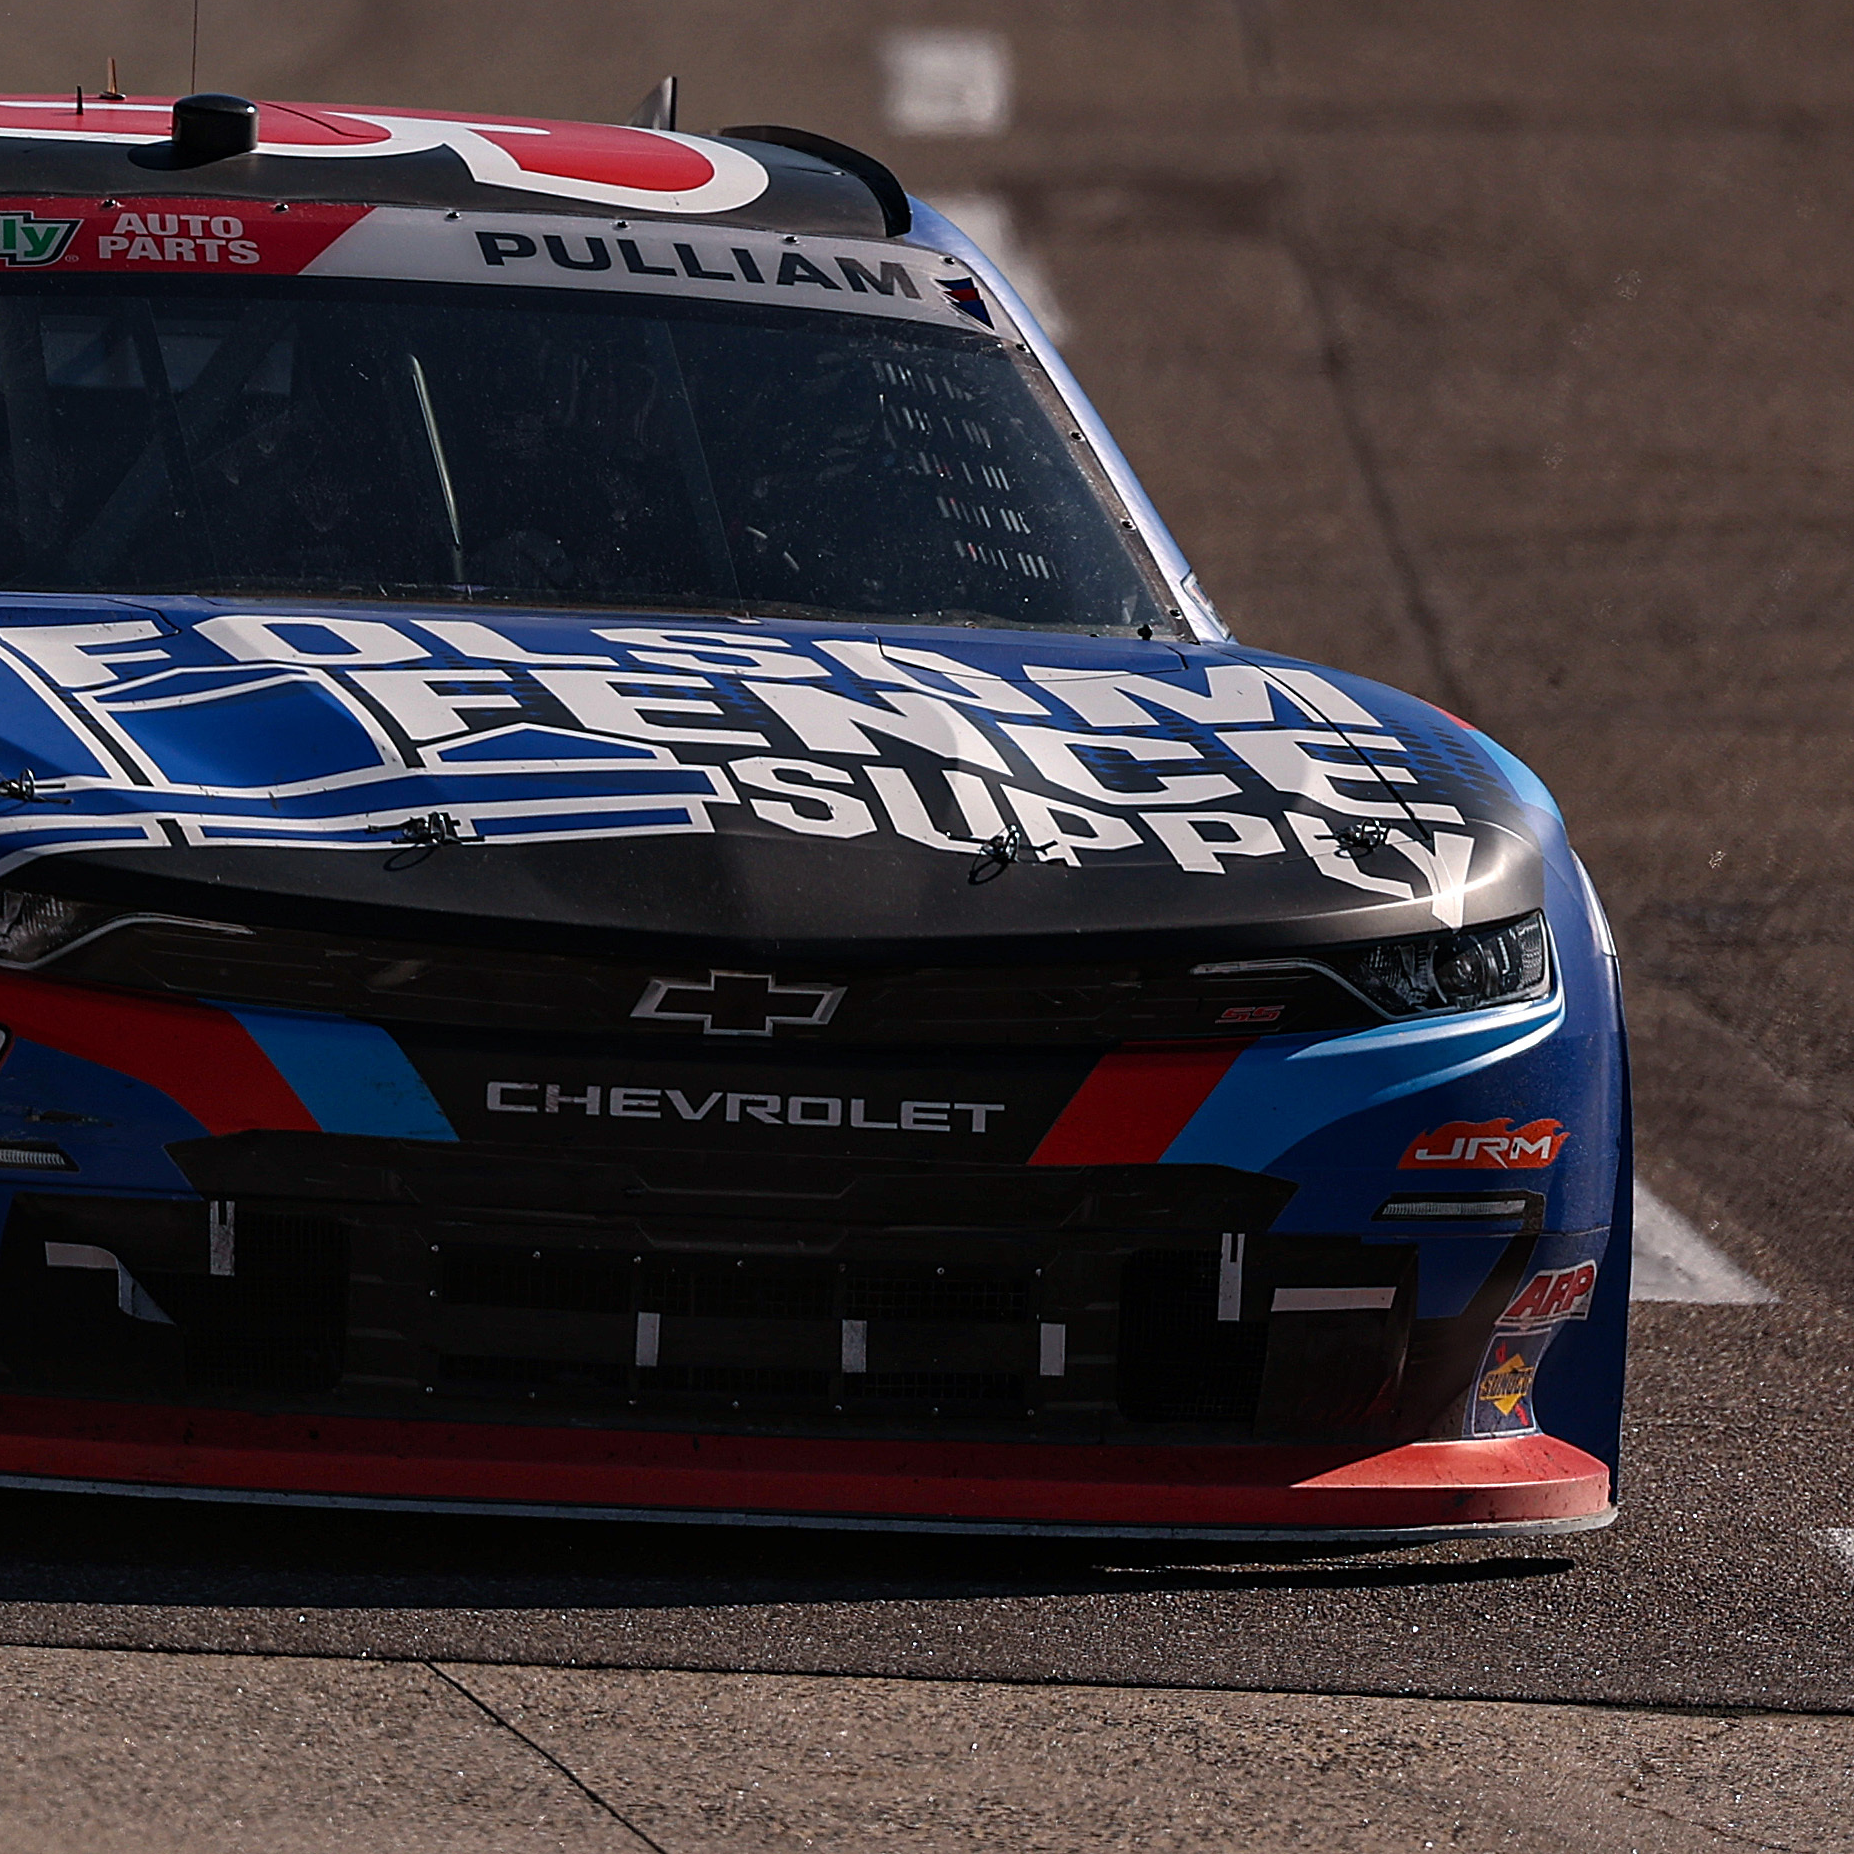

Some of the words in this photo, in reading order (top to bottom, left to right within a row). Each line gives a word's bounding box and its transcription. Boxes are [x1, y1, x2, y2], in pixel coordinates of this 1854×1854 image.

[98, 236, 262, 265] PARTS
[112, 213, 244, 239] AUTO
[474, 230, 922, 301] PULLIAM
[348, 668, 1464, 824] FENCE
[729, 755, 1477, 933] SUPPLY
[486, 1079, 1007, 1134] CHEVROLET
[1414, 1135, 1553, 1170] JRM
[1503, 1264, 1594, 1317] ARP
